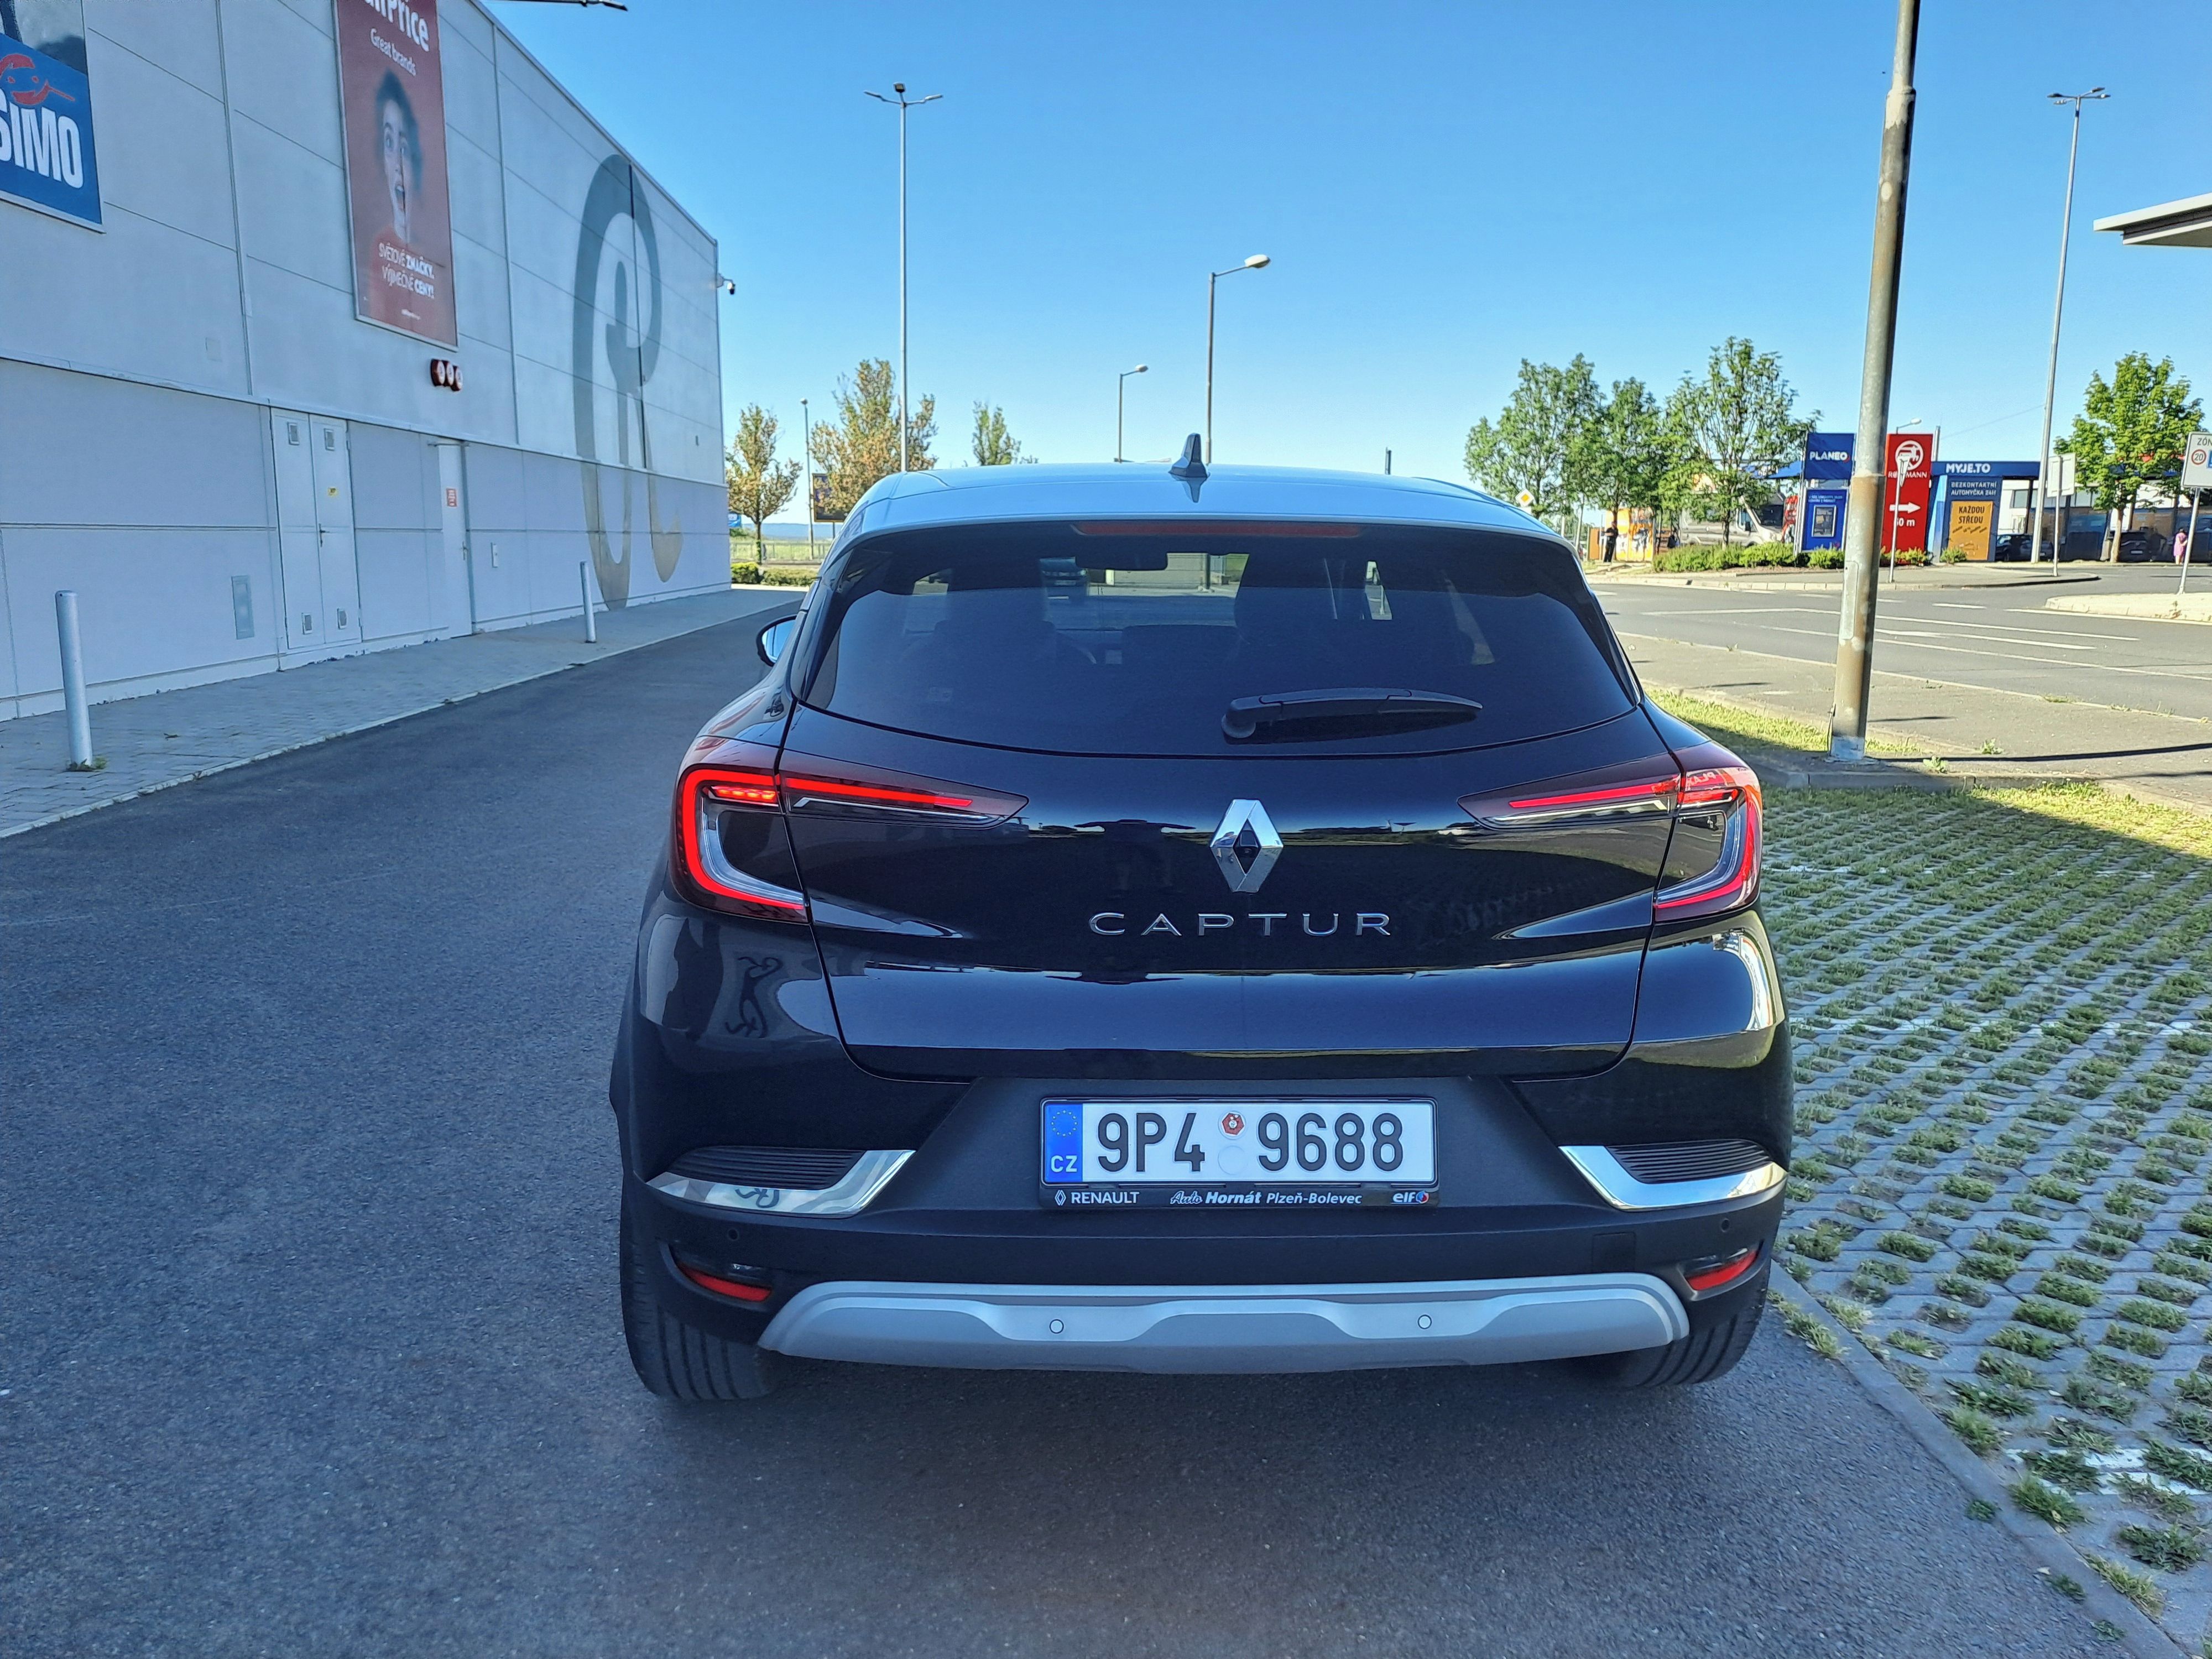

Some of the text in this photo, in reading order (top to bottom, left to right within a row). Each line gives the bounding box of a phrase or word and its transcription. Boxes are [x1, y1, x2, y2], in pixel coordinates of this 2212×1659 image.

[1809, 451, 1848, 461] PLANEO
[2194, 453, 2203, 461] 20
[1946, 463, 1991, 473] MYJE.TO
[1959, 505, 1985, 514] KAŽDOU
[1958, 515, 1984, 524] STŘEDU
[1088, 912, 1391, 937] CAPTUR
[1098, 1112, 1404, 1172] 9P4 9688
[1051, 1155, 1078, 1173] CZ
[1071, 1191, 1140, 1204] RENAULT
[1170, 1190, 1363, 1204] Auto Hornát Plzeň-Bolevec
[1392, 1192, 1417, 1203] elf
